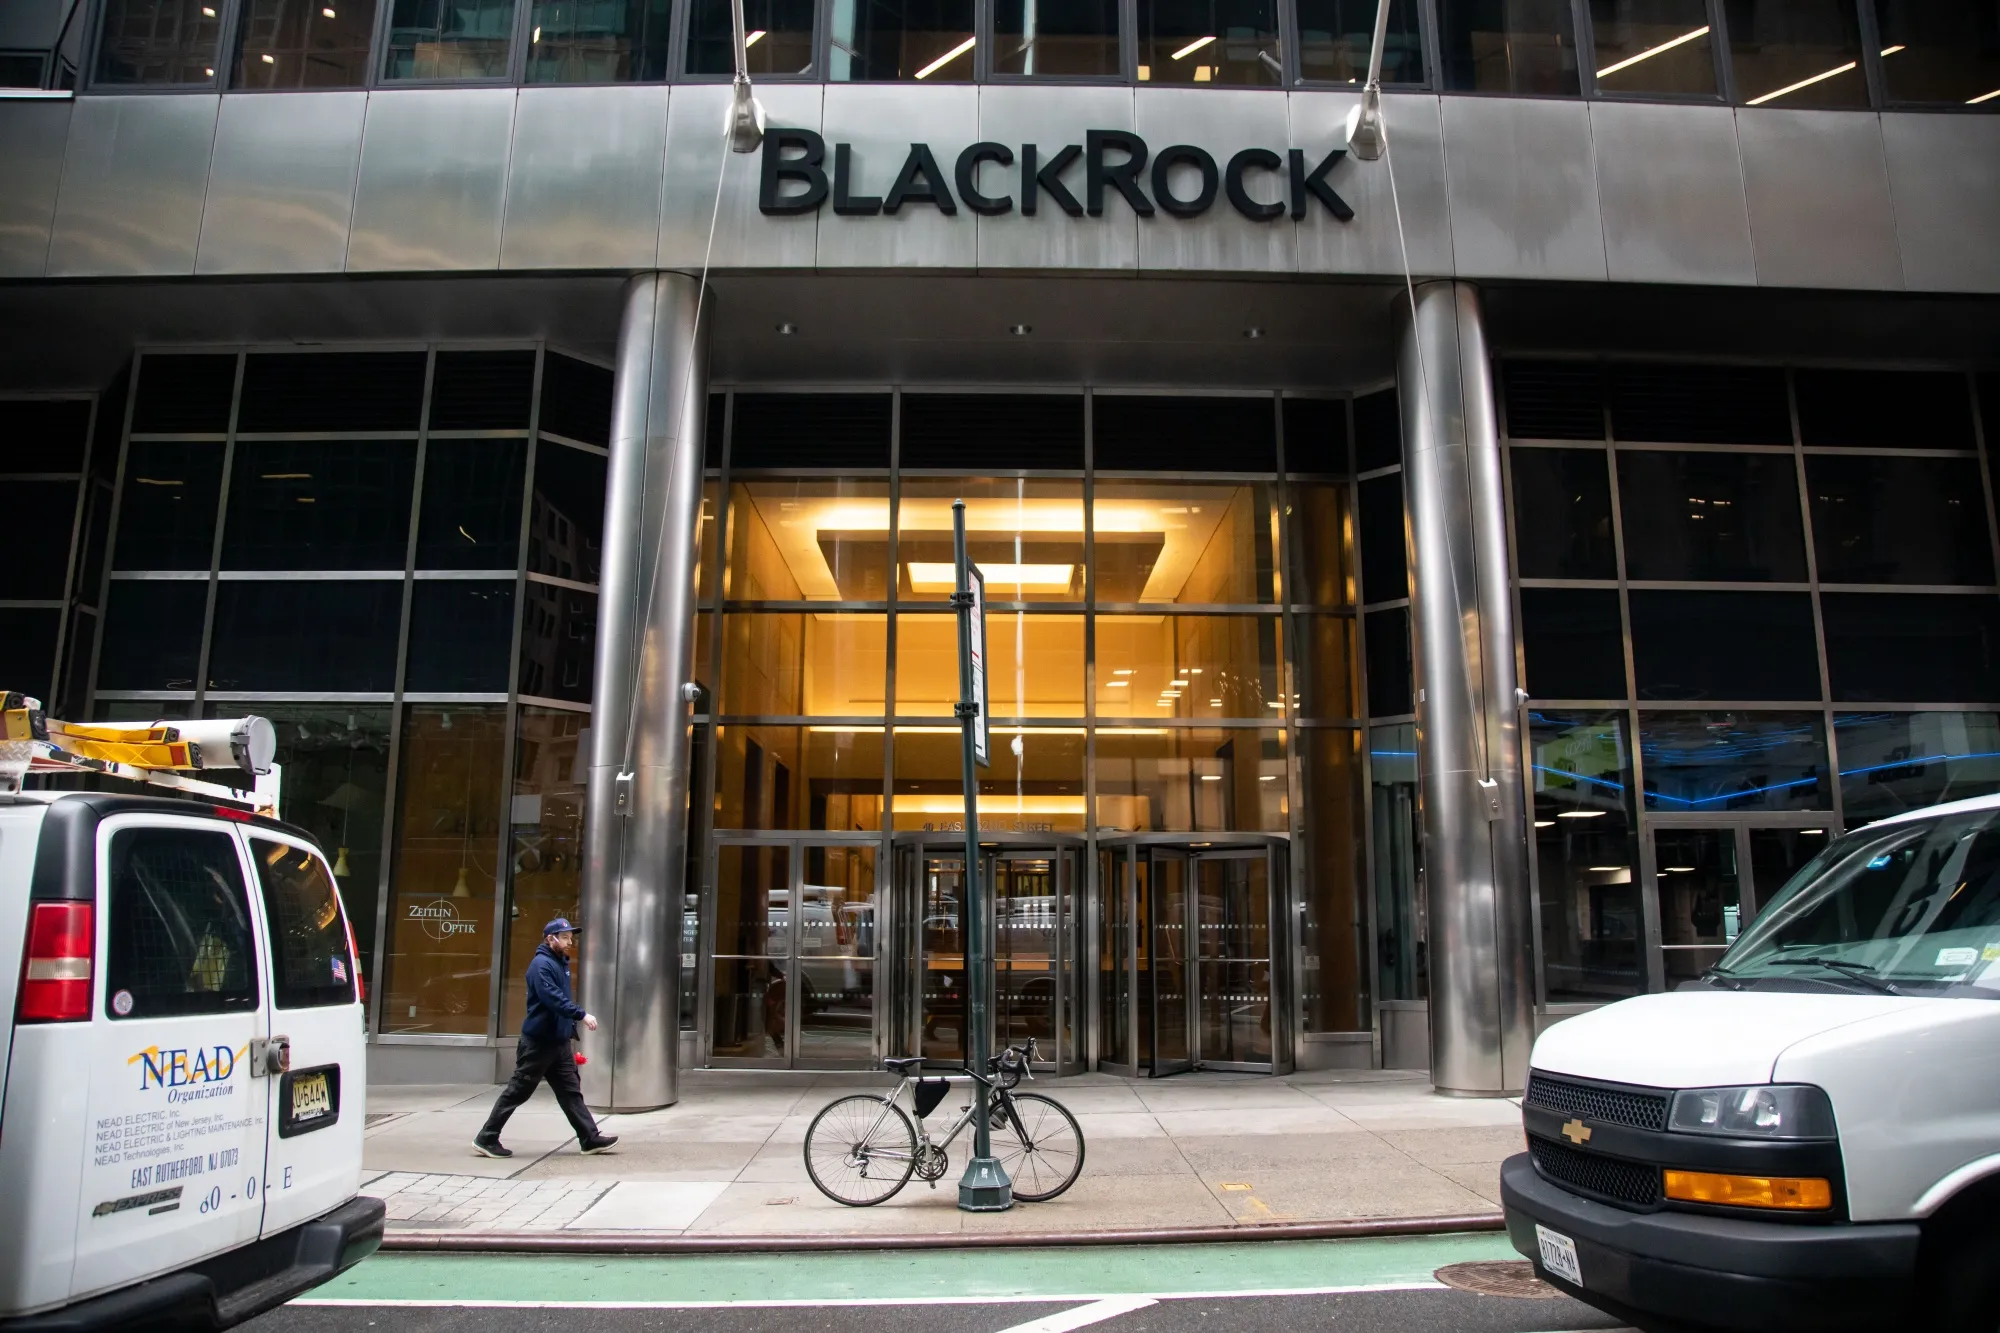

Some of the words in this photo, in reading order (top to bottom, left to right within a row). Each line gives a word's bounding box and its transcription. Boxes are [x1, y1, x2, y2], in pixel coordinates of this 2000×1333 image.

[758, 128, 1354, 221] BLACKROCK
[940, 821, 963, 832] EAS
[1012, 821, 1054, 832] STREET
[409, 905, 452, 918] ZEITLIN
[441, 921, 476, 933] OPTIK
[138, 1045, 234, 1091] NEAD
[167, 1082, 234, 1104] Organization
[95, 1129, 122, 1142] NEAD
[124, 1121, 165, 1138] ELECTRIC
[166, 1120, 173, 1130] of
[174, 1119, 190, 1128] New
[96, 1116, 123, 1130] NEAD
[95, 1141, 121, 1154] NEAD
[123, 1133, 164, 1149] ELECTRIC
[165, 1132, 171, 1142] &
[172, 1126, 207, 1141] LIGHTING
[94, 1152, 121, 1167] NEAD
[131, 1165, 154, 1189] EAST
[155, 1155, 206, 1184] RUTHERFORD,
[208, 1151, 219, 1172] NJ
[219, 1147, 239, 1169] 07073
[283, 1166, 293, 1190] E
